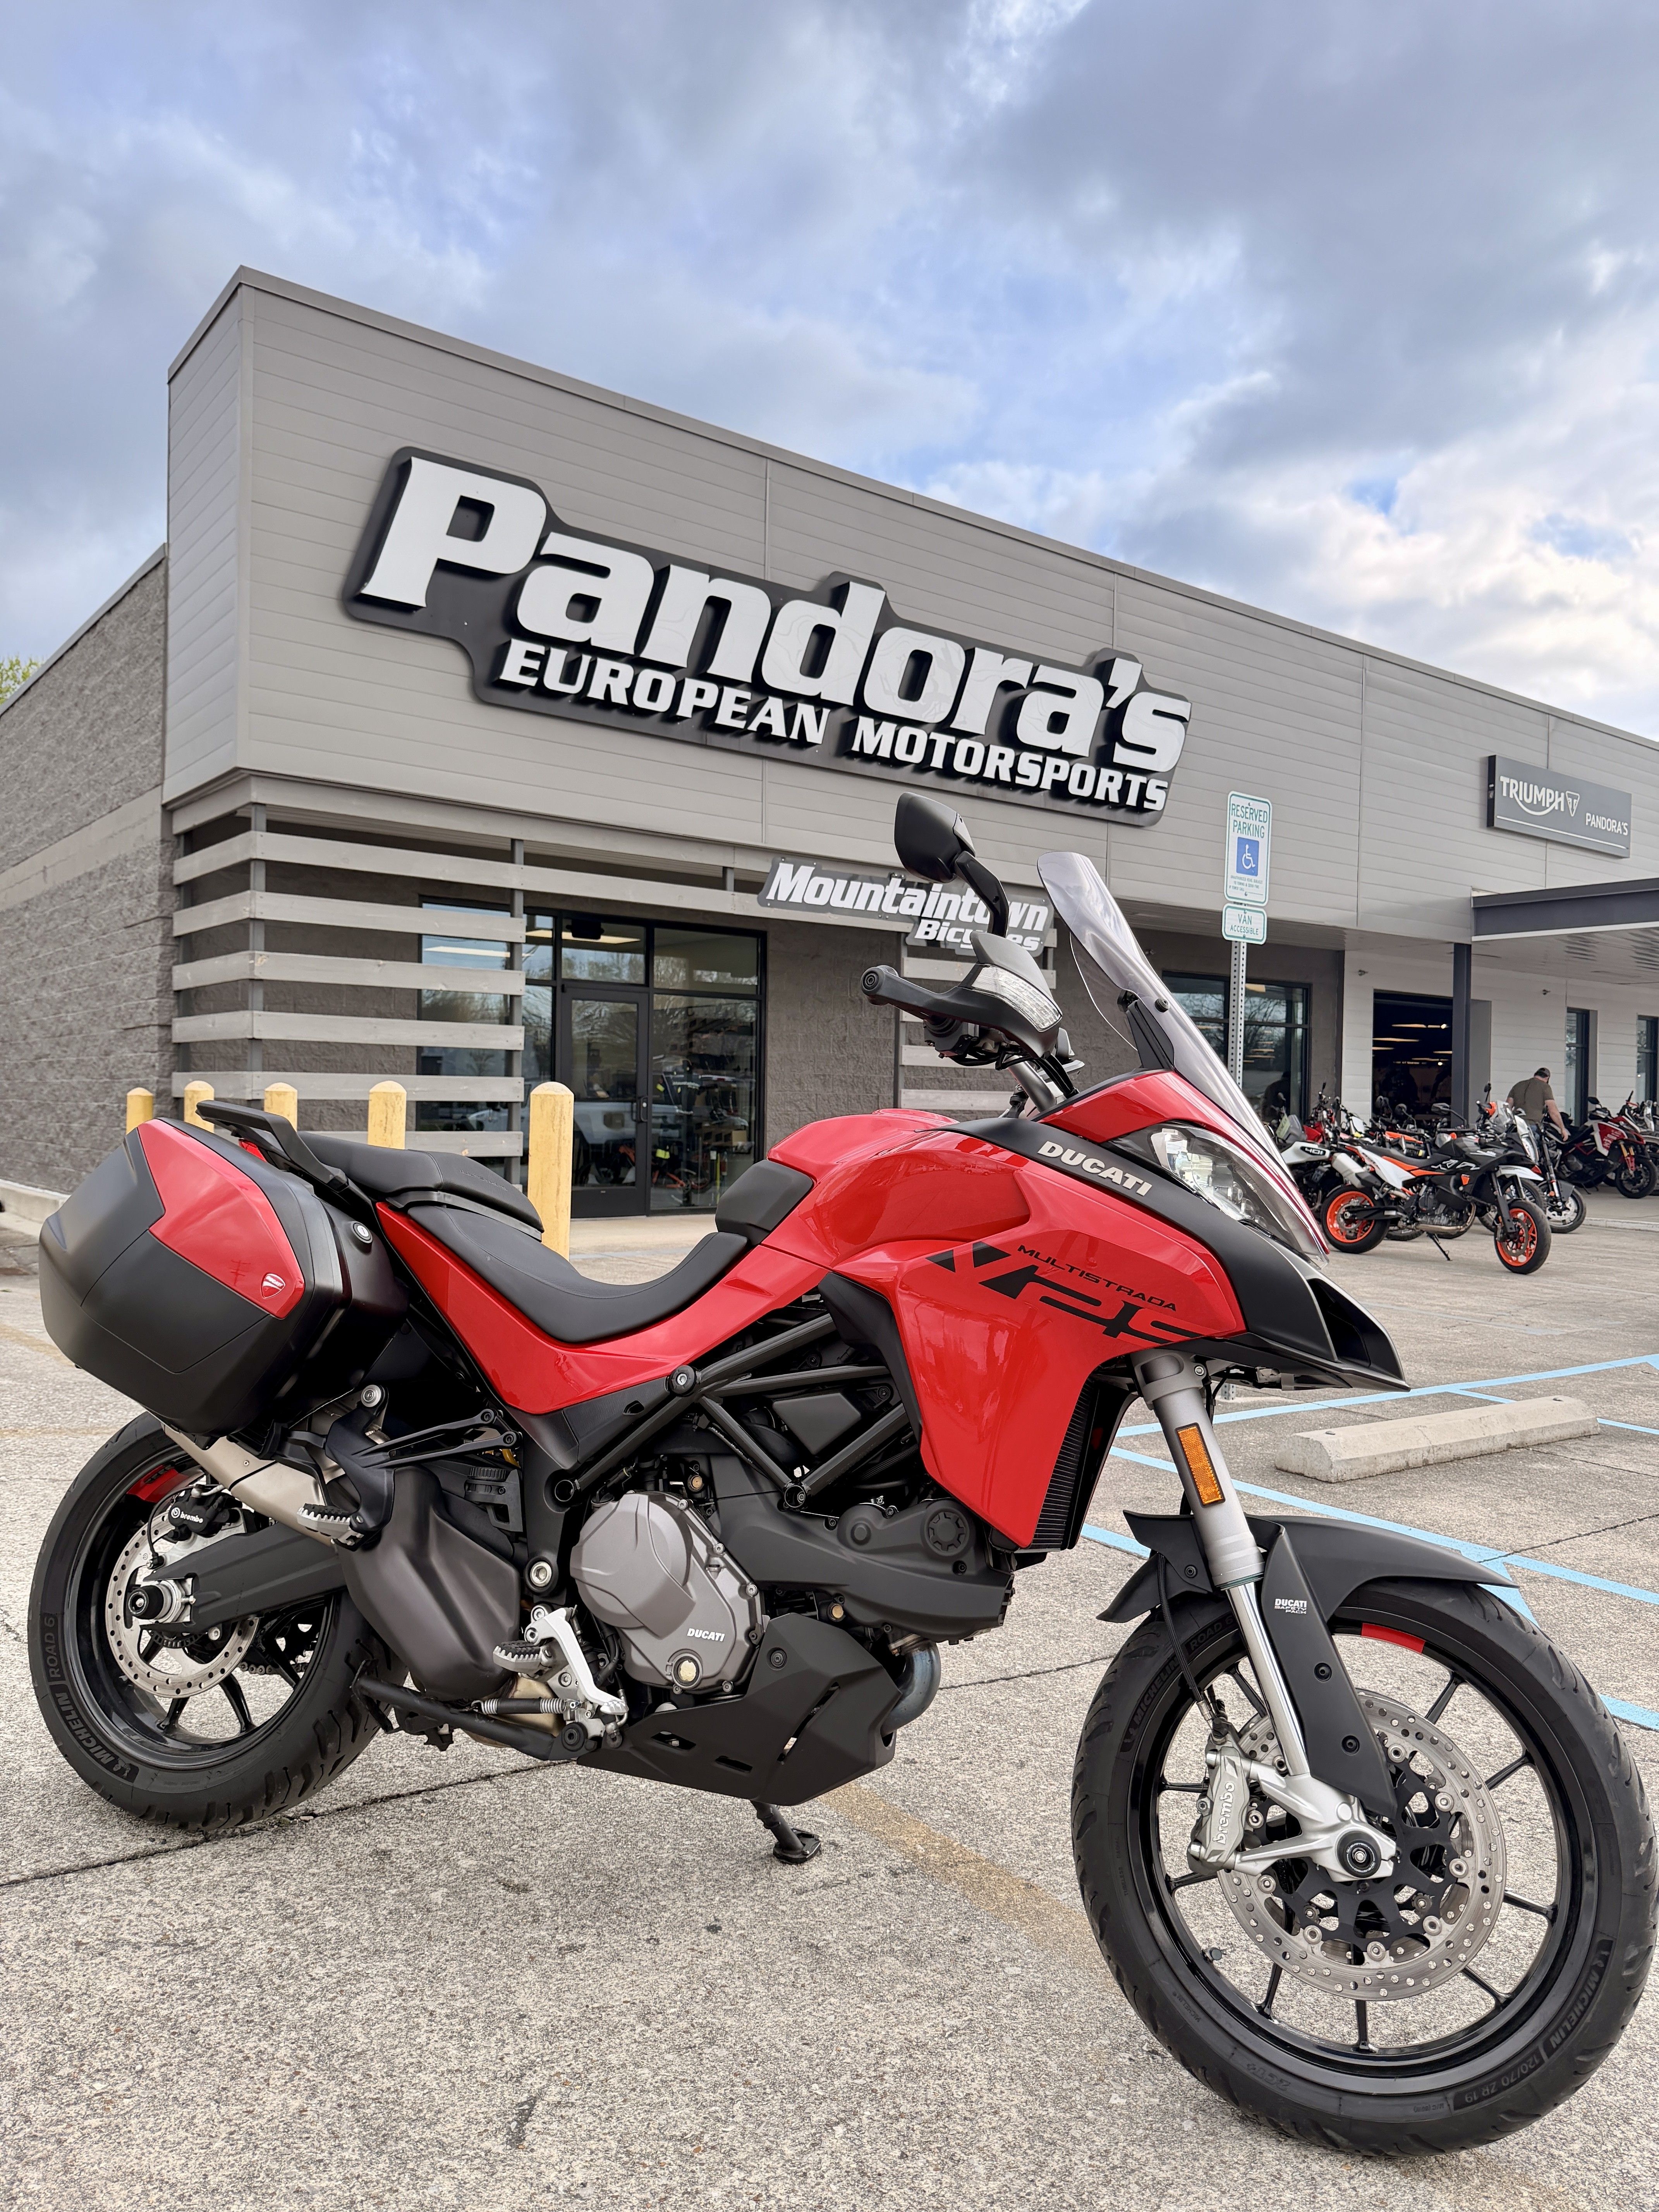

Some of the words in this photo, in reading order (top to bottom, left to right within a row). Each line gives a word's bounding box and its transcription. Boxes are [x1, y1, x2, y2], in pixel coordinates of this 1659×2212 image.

[360, 456, 1192, 772] Pandora's
[499, 638, 830, 745] EUROPEAN
[852, 716, 1169, 811] MOTORSPORTS
[1499, 776, 1565, 816] TRIUMPH
[1231, 803, 1267, 823] RESERVED
[1585, 812, 1628, 836] PANDORA'S
[1233, 819, 1265, 838] PARKING
[1230, 925, 1259, 935] ACCESSIBLE
[1238, 914, 1252, 925] VAN
[1037, 1140, 1152, 1197] DUCATI
[1018, 1245, 1176, 1312] MULTISTRADA
[180, 1511, 203, 1523] brembo
[1274, 1598, 1307, 1608] DUCATI
[44, 1616, 55, 1627] 6
[687, 1628, 725, 1642] DUCATI
[44, 1632, 61, 1678] ROAD
[55, 1692, 115, 1765] MICHELIN
[1212, 1781, 1235, 1844] brembo
[1549, 1969, 1599, 2049] MICHELIN
[1501, 2054, 1540, 2087] 120/70
[1465, 2091, 1479, 2103] 19
[1482, 2081, 1496, 2097] ZR
